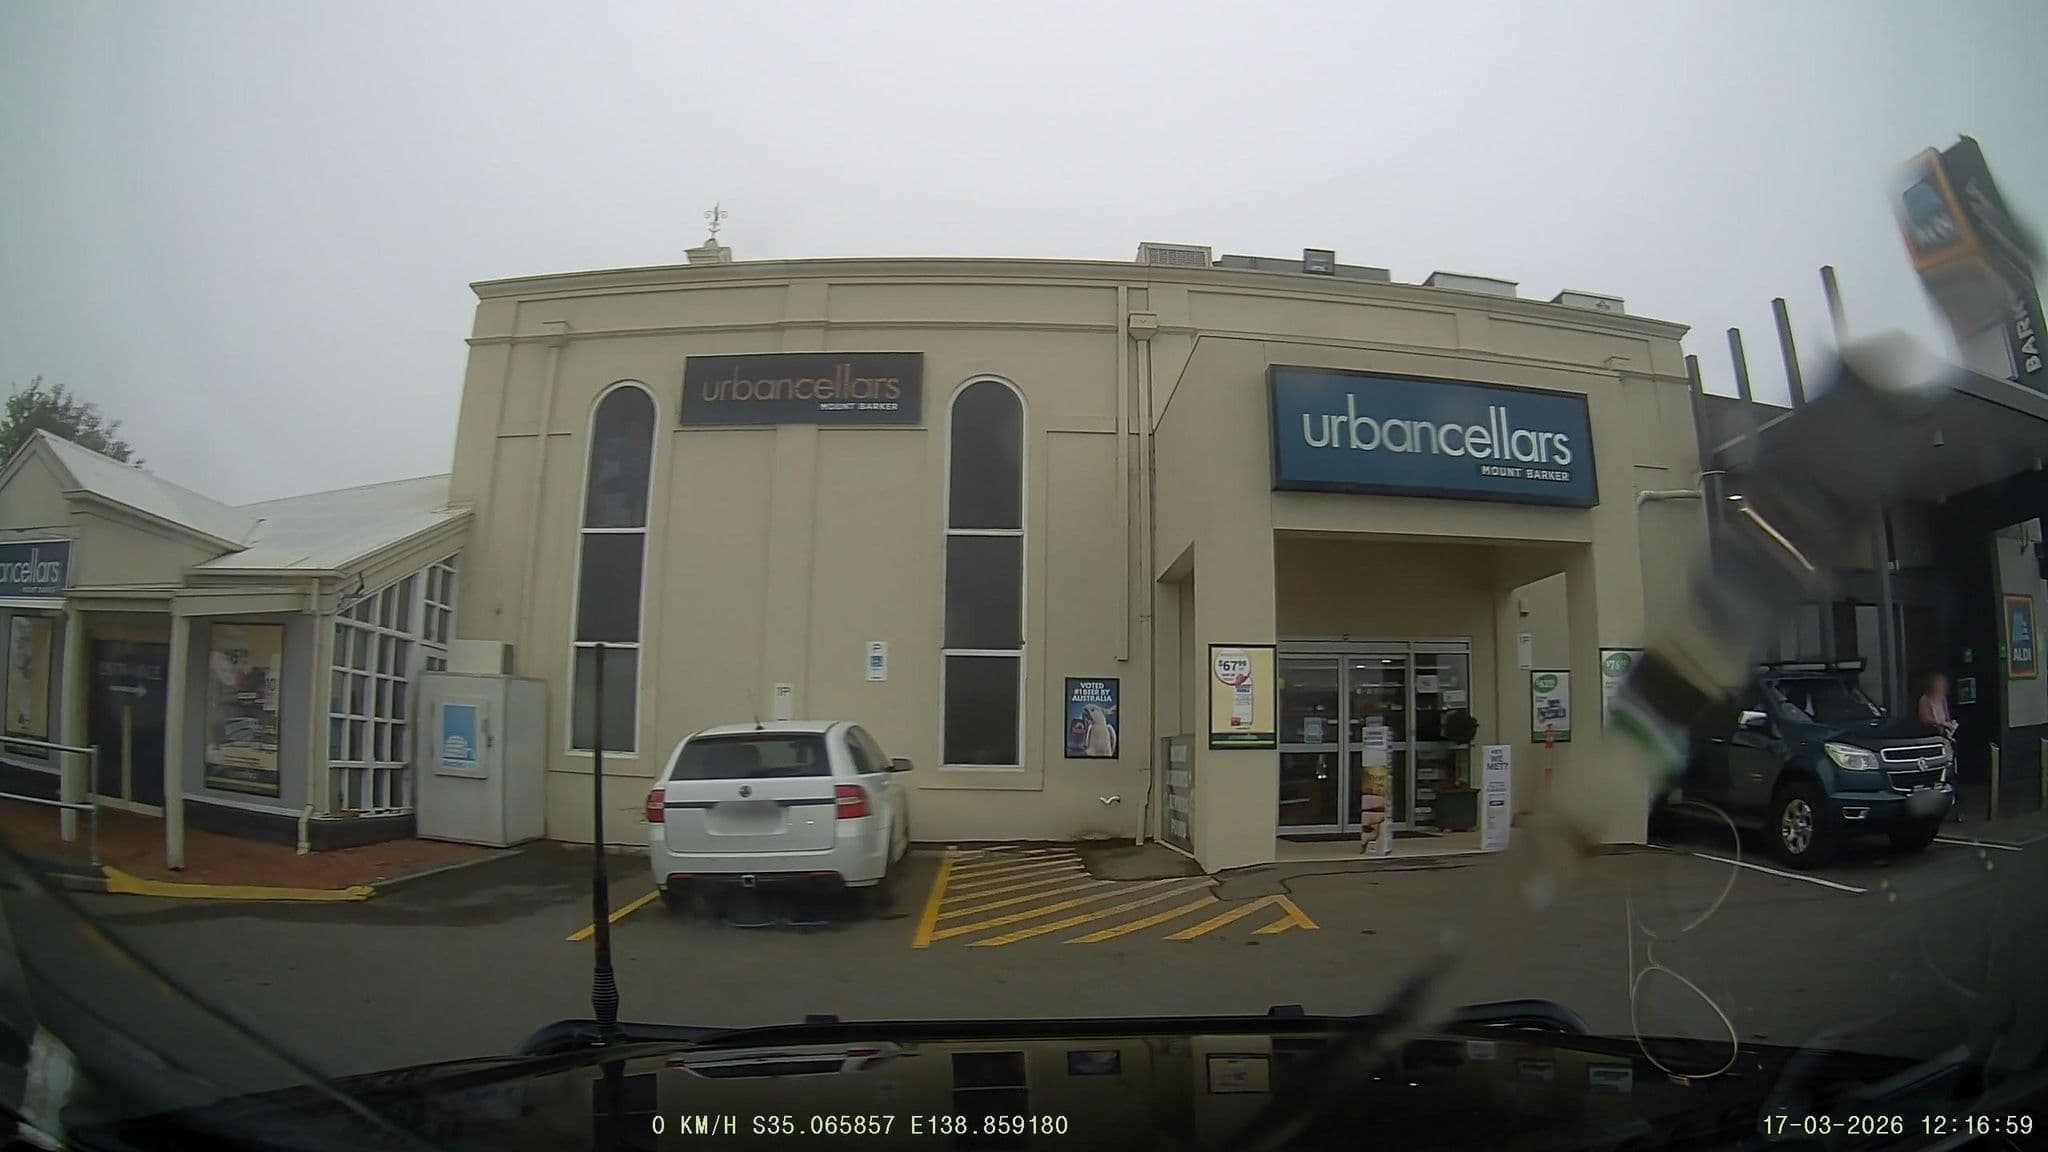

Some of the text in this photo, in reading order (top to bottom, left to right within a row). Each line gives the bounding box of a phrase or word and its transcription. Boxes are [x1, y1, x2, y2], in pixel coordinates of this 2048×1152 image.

[703, 363, 900, 402] urbancellars
[820, 402, 898, 411] MOUNT BARKER
[1303, 393, 1573, 466] urbancellars
[1481, 464, 1570, 482] MOUNT BARKER
[2013, 647, 2033, 662] ALDI
